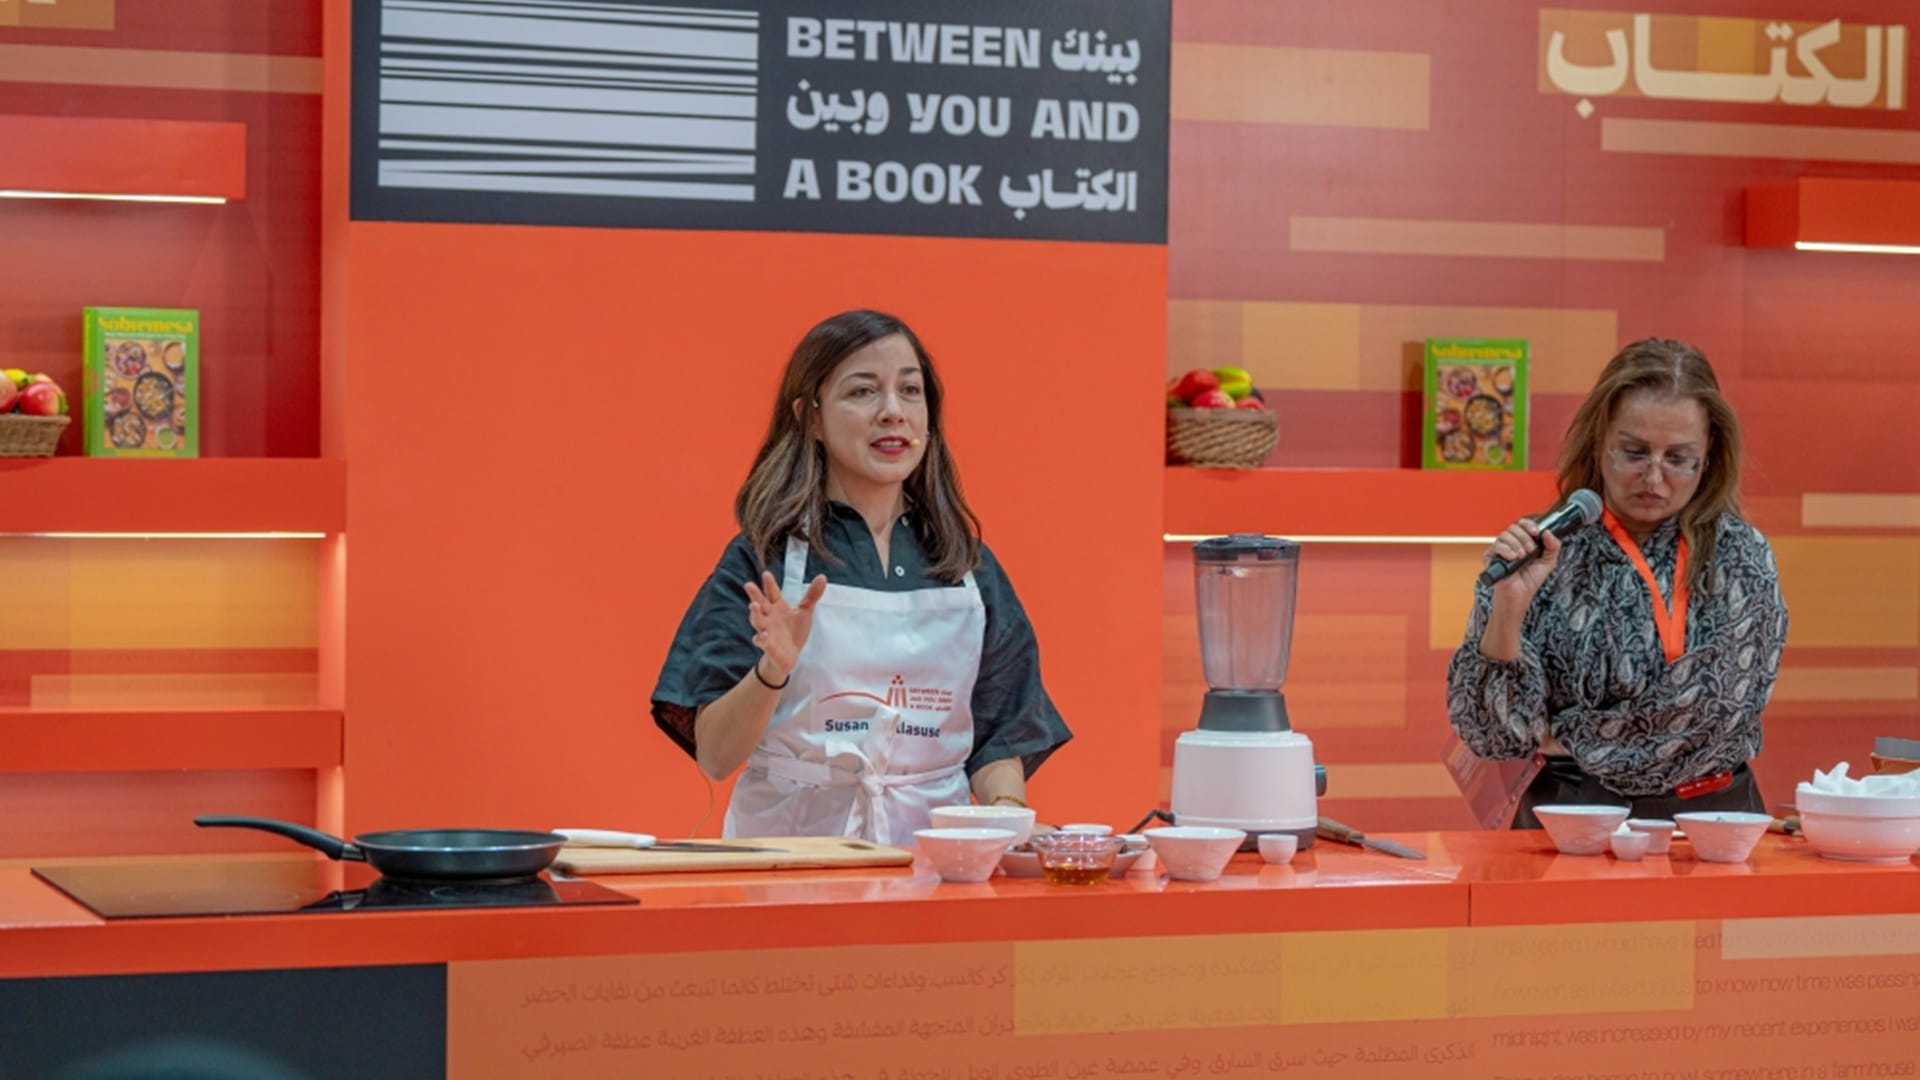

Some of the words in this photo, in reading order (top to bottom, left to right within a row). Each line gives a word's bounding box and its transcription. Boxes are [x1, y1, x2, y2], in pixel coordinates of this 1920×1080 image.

[787, 17, 1041, 69] BETWEEN
[1051, 29, 1141, 86] بينك
[1546, 13, 1905, 119] الكتاب
[786, 79, 890, 135] وبين
[906, 92, 1012, 137] YOU
[1030, 98, 1141, 142] AND
[783, 158, 821, 200] A
[836, 160, 983, 206] BOOK
[998, 167, 1138, 221] الكتاب
